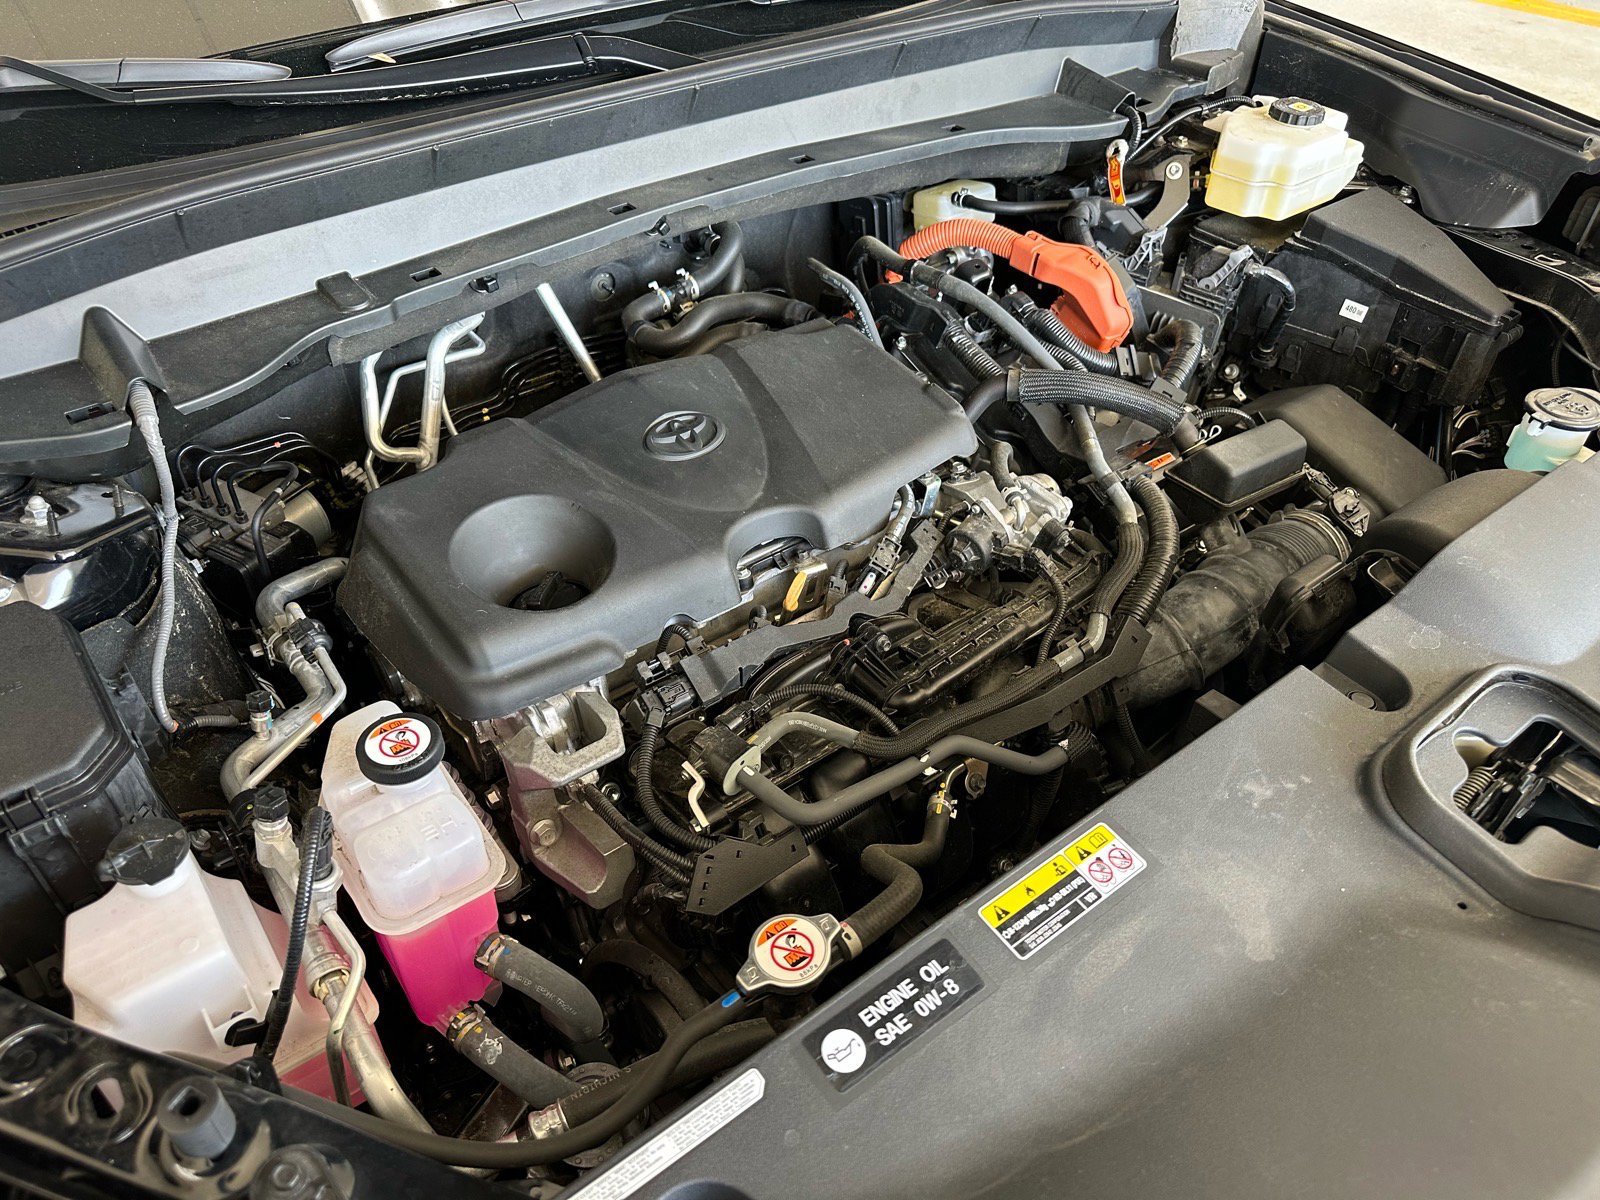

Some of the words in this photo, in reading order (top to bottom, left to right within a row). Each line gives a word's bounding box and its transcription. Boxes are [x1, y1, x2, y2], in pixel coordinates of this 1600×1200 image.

[858, 978, 919, 1028] ENGINE
[919, 959, 950, 983] OIL
[874, 1012, 913, 1046] SAE
[913, 978, 960, 1017] 0W-8
